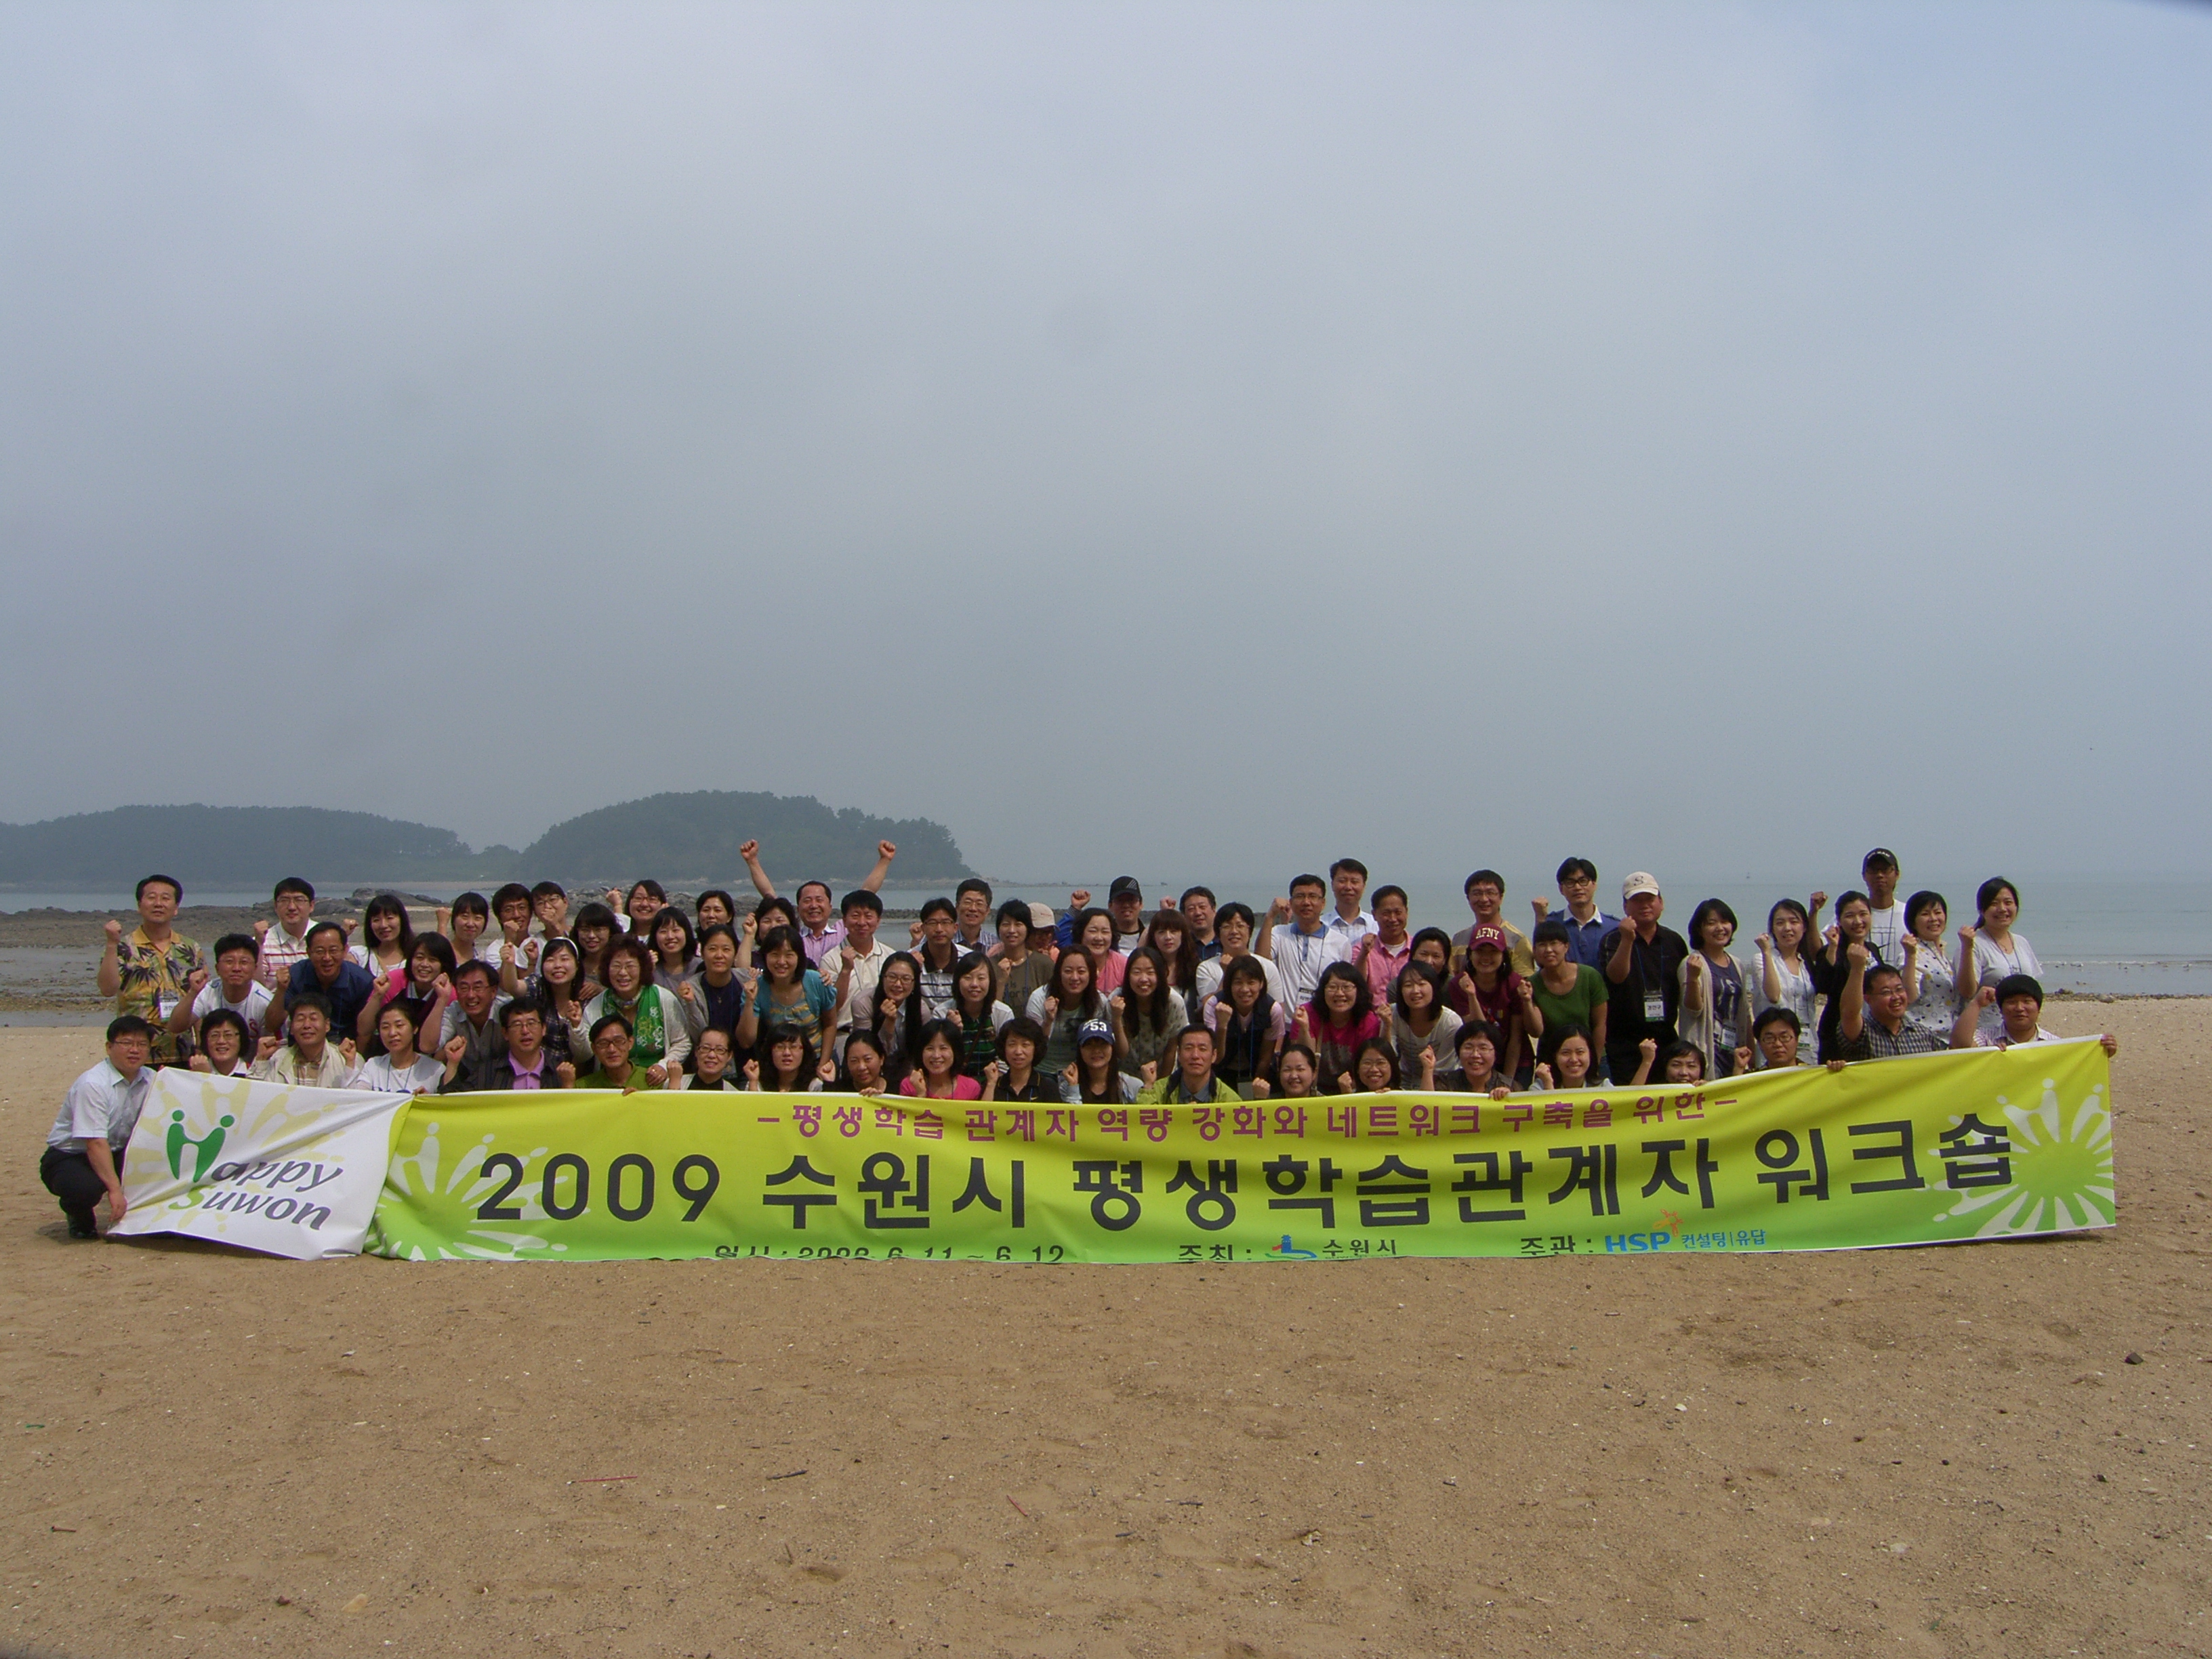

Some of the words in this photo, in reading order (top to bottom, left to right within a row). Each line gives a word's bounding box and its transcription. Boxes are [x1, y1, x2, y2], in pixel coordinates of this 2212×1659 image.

[964, 1109, 1080, 1142] 관계자
[1097, 1108, 1173, 1143] 역량
[1192, 1105, 1309, 1141] 강화와
[1327, 1105, 1480, 1139] 네트워크
[1502, 1098, 1614, 1133] 구축을
[166, 1109, 344, 1192] Happy
[478, 1153, 720, 1222] 2009
[763, 1151, 1025, 1229] 수원시
[1073, 1139, 1719, 1231] 평생학습관계자
[1755, 1113, 2012, 1204] 워크숍
[1323, 1240, 1397, 1256] 수원시
[1605, 1232, 1671, 1253] HSP
